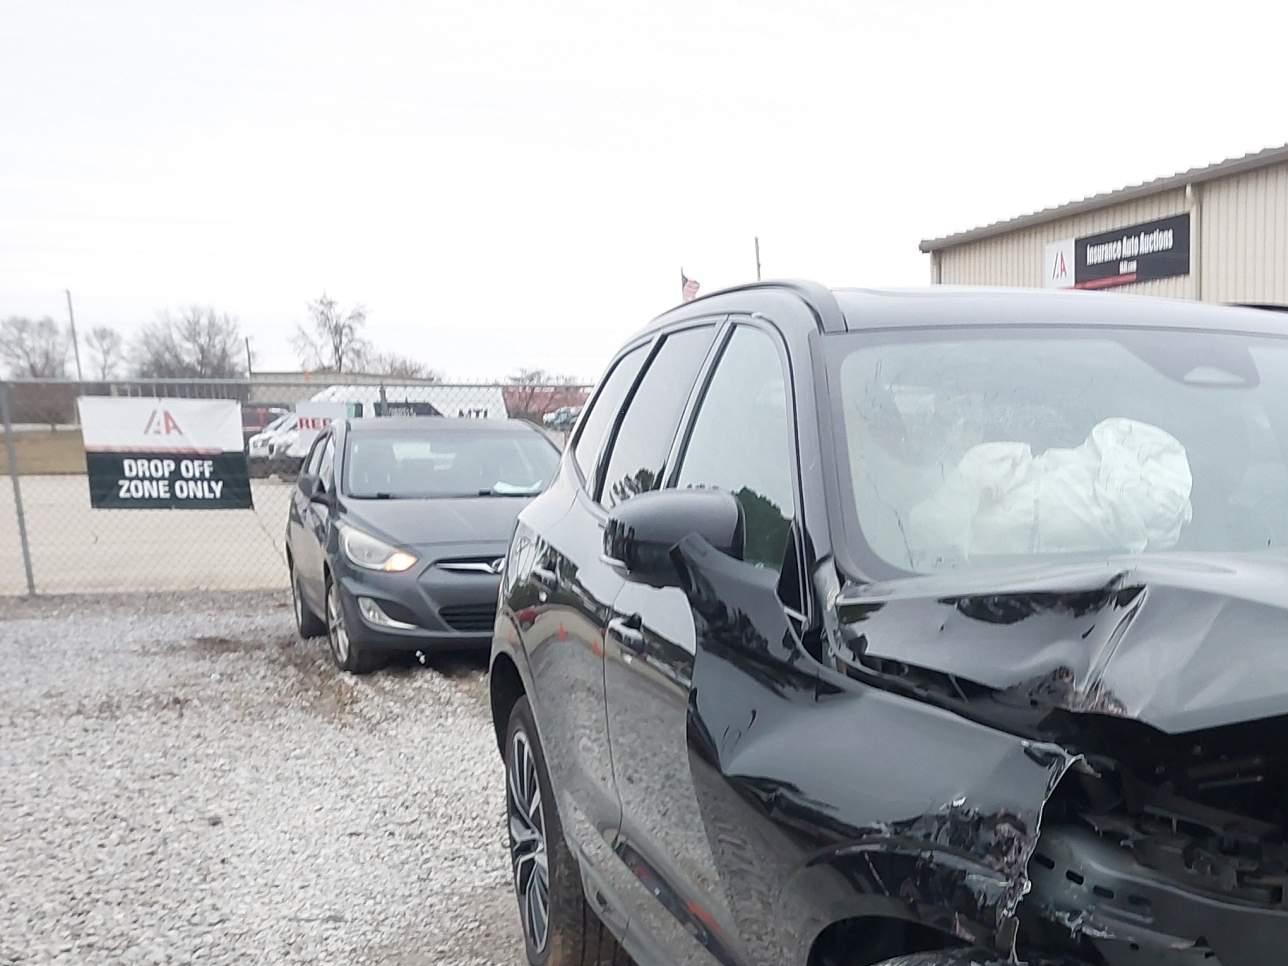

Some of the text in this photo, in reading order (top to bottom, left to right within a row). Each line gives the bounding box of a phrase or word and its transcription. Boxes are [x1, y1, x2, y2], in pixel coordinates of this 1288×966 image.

[1086, 229, 1173, 265] Insurance Auto Auctions
[123, 459, 214, 478] DROP OFF
[118, 480, 223, 499] ZONE ONLY
